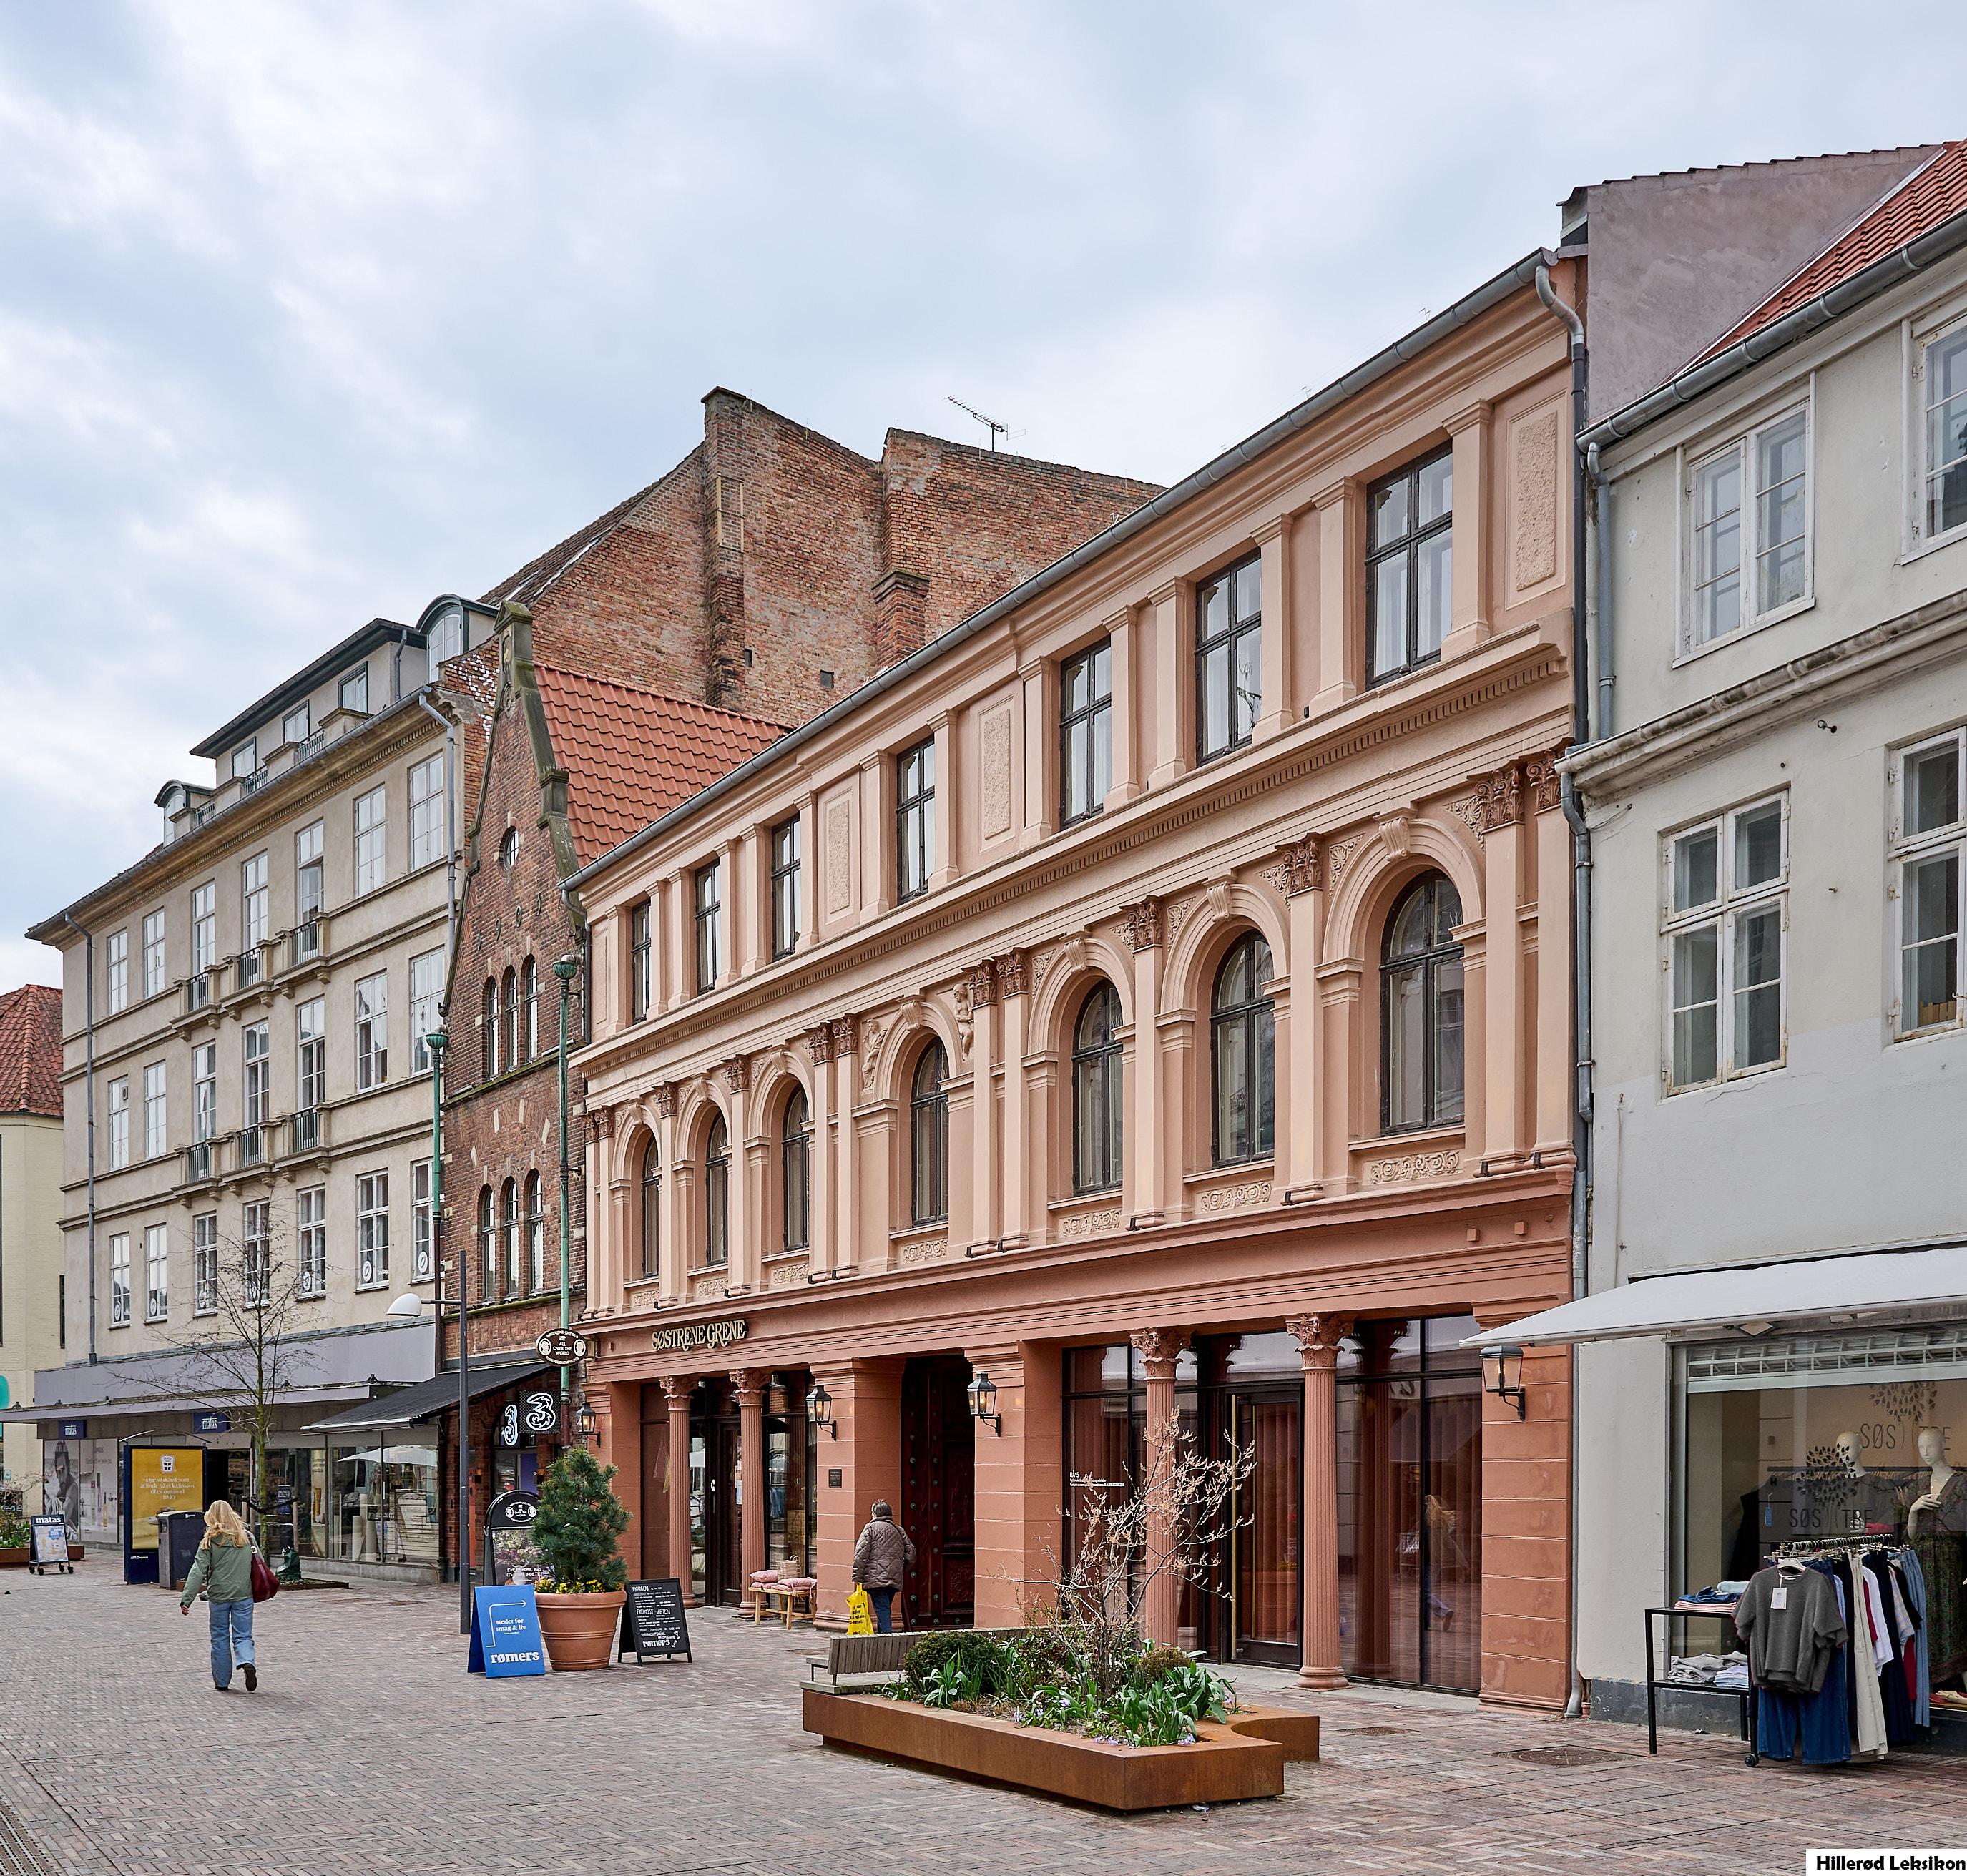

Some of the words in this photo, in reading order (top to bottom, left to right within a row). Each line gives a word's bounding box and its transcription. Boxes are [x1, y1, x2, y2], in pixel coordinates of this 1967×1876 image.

[652, 1325, 705, 1351] SØSTRENE
[707, 1320, 745, 1349] GRENE
[490, 1651, 540, 1664] rømers
